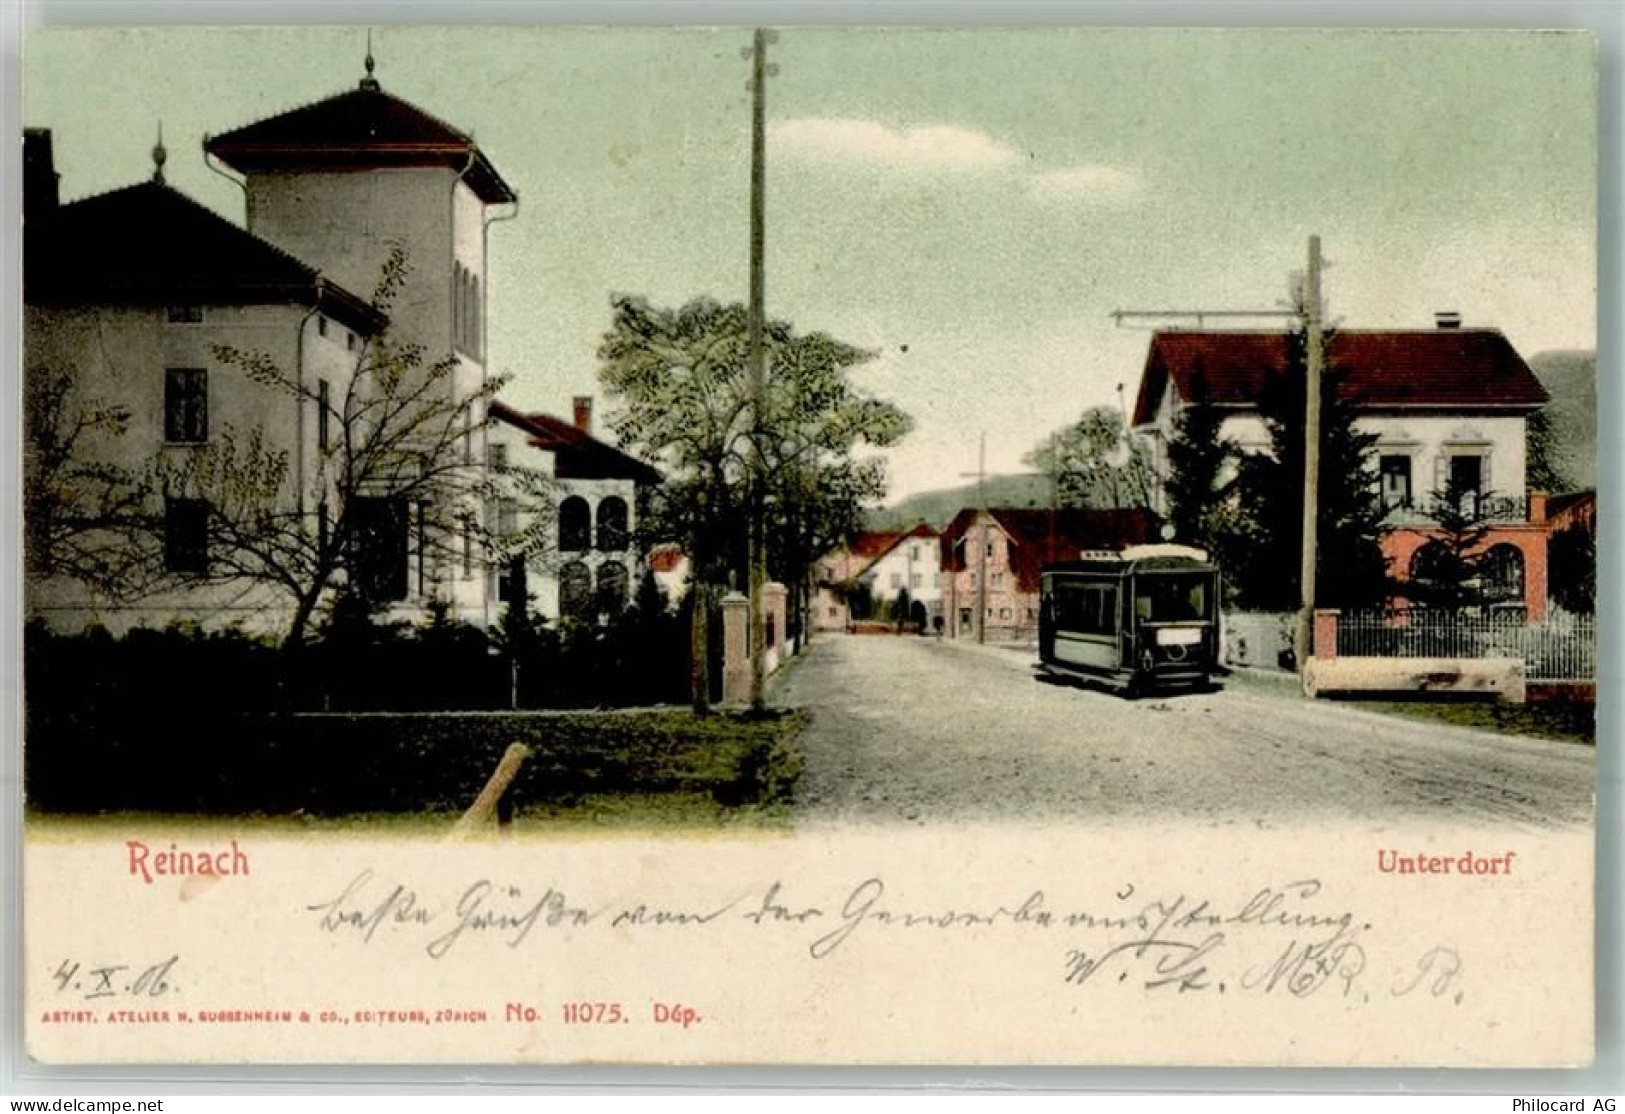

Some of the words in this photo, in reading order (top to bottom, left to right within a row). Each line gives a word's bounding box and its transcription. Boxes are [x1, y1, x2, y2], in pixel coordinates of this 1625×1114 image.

[125, 839, 249, 884] Reinach
[1377, 849, 1516, 875] Unterdorf
[107, 1011, 170, 1023] ATELIER
[506, 1003, 541, 1023] No.
[563, 1003, 629, 1024] 11075.
